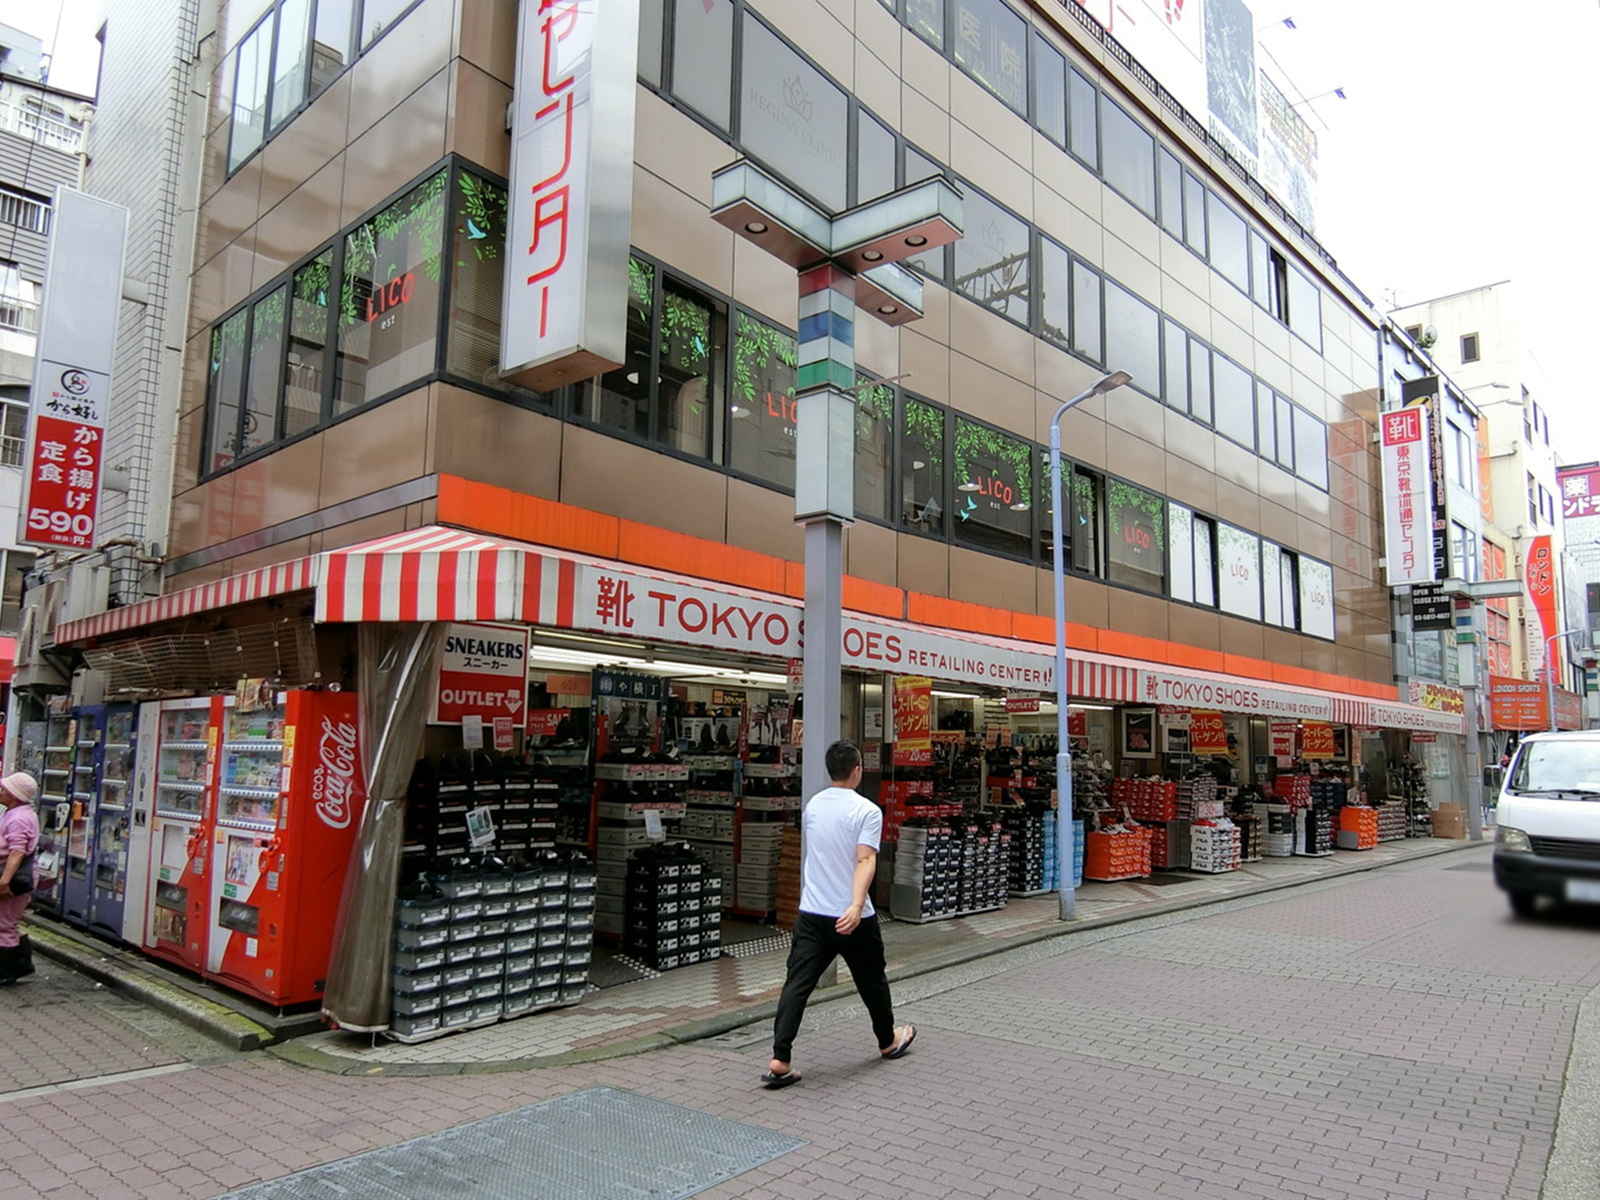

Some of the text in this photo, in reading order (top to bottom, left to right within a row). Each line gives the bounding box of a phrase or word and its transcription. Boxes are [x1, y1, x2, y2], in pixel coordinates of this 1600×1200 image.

[366, 272, 415, 323] LICO
[381, 314, 395, 330] est
[766, 391, 798, 423] LIC
[1388, 415, 1415, 441] 靴
[38, 440, 67, 484] 定食
[66, 426, 98, 510] から揚げ
[977, 475, 1012, 504] LICO
[28, 508, 93, 536] 590
[1396, 445, 1415, 579] 東京靴流通センター
[1123, 525, 1149, 549] LICO
[1231, 563, 1249, 581] LICO
[1537, 549, 1551, 596] ロンドン
[596, 576, 635, 629] 靴
[445, 636, 523, 660] SNEAKERS
[648, 591, 790, 646] TOKYO
[908, 649, 985, 676] RETAILING
[463, 657, 509, 669] スニーカー
[440, 688, 505, 707] OUTLET
[1162, 679, 1213, 703] TOKYO
[1216, 685, 1259, 709] SHOES
[1261, 699, 1297, 712] RETAILING
[1191, 718, 1212, 730] スーパー
[1378, 708, 1402, 725] TOKYO
[1403, 712, 1426, 727] SHOES
[315, 714, 357, 829] Coca-Cola
